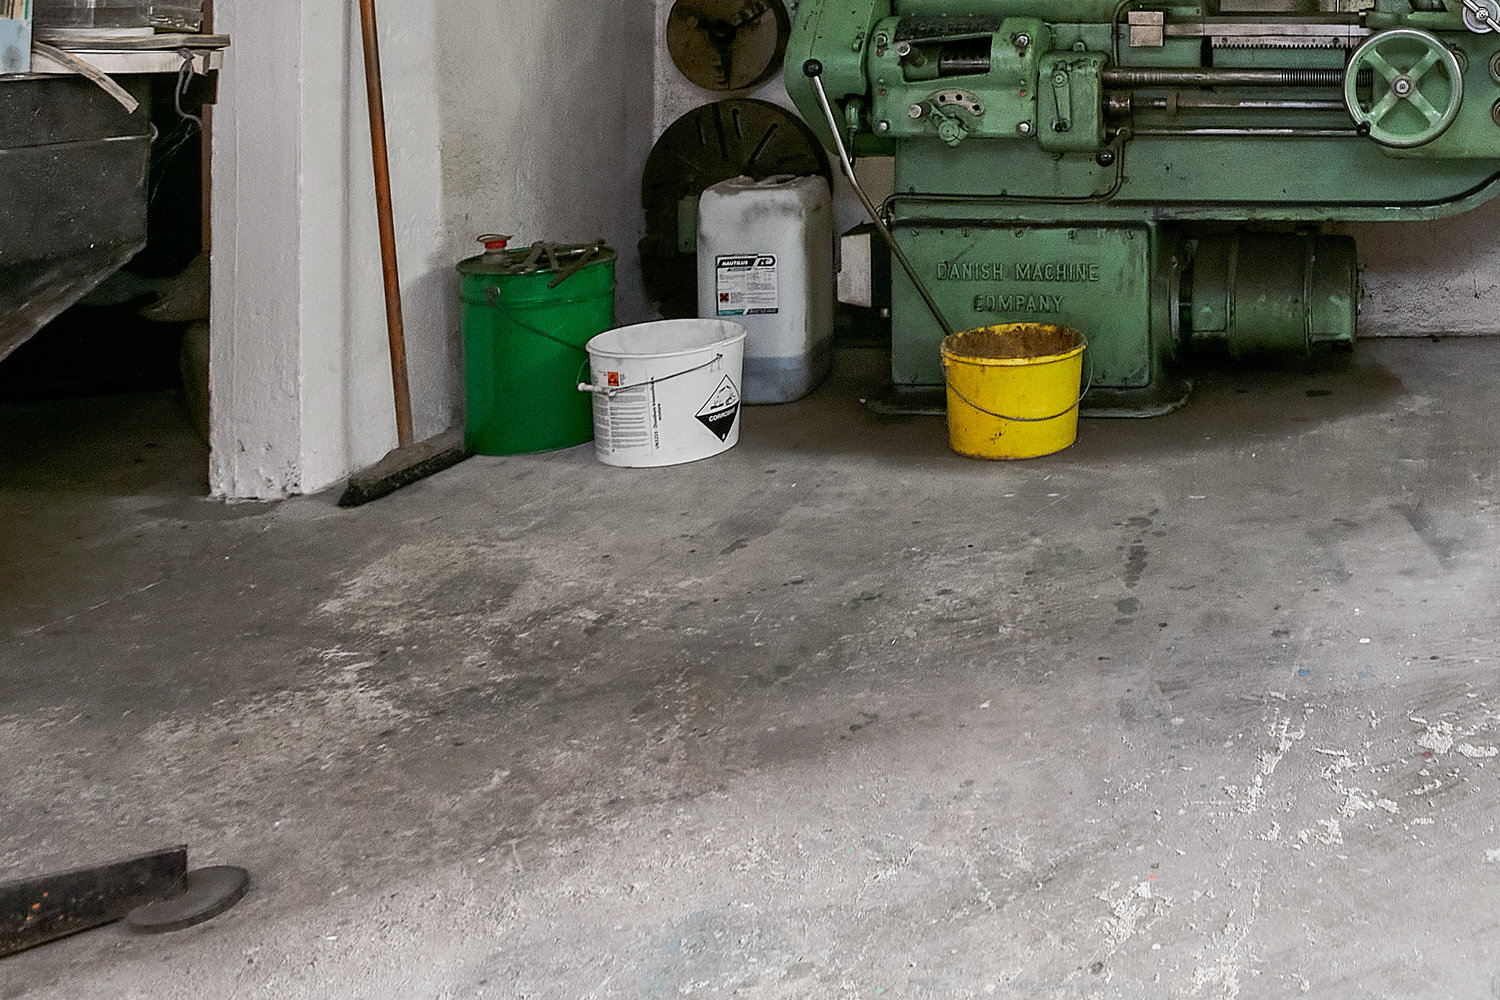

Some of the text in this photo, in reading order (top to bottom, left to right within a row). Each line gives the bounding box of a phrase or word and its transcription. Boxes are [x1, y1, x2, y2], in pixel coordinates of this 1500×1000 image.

[936, 262, 1100, 282] DANISH MACHINE
[974, 294, 1064, 313] COMPANY
